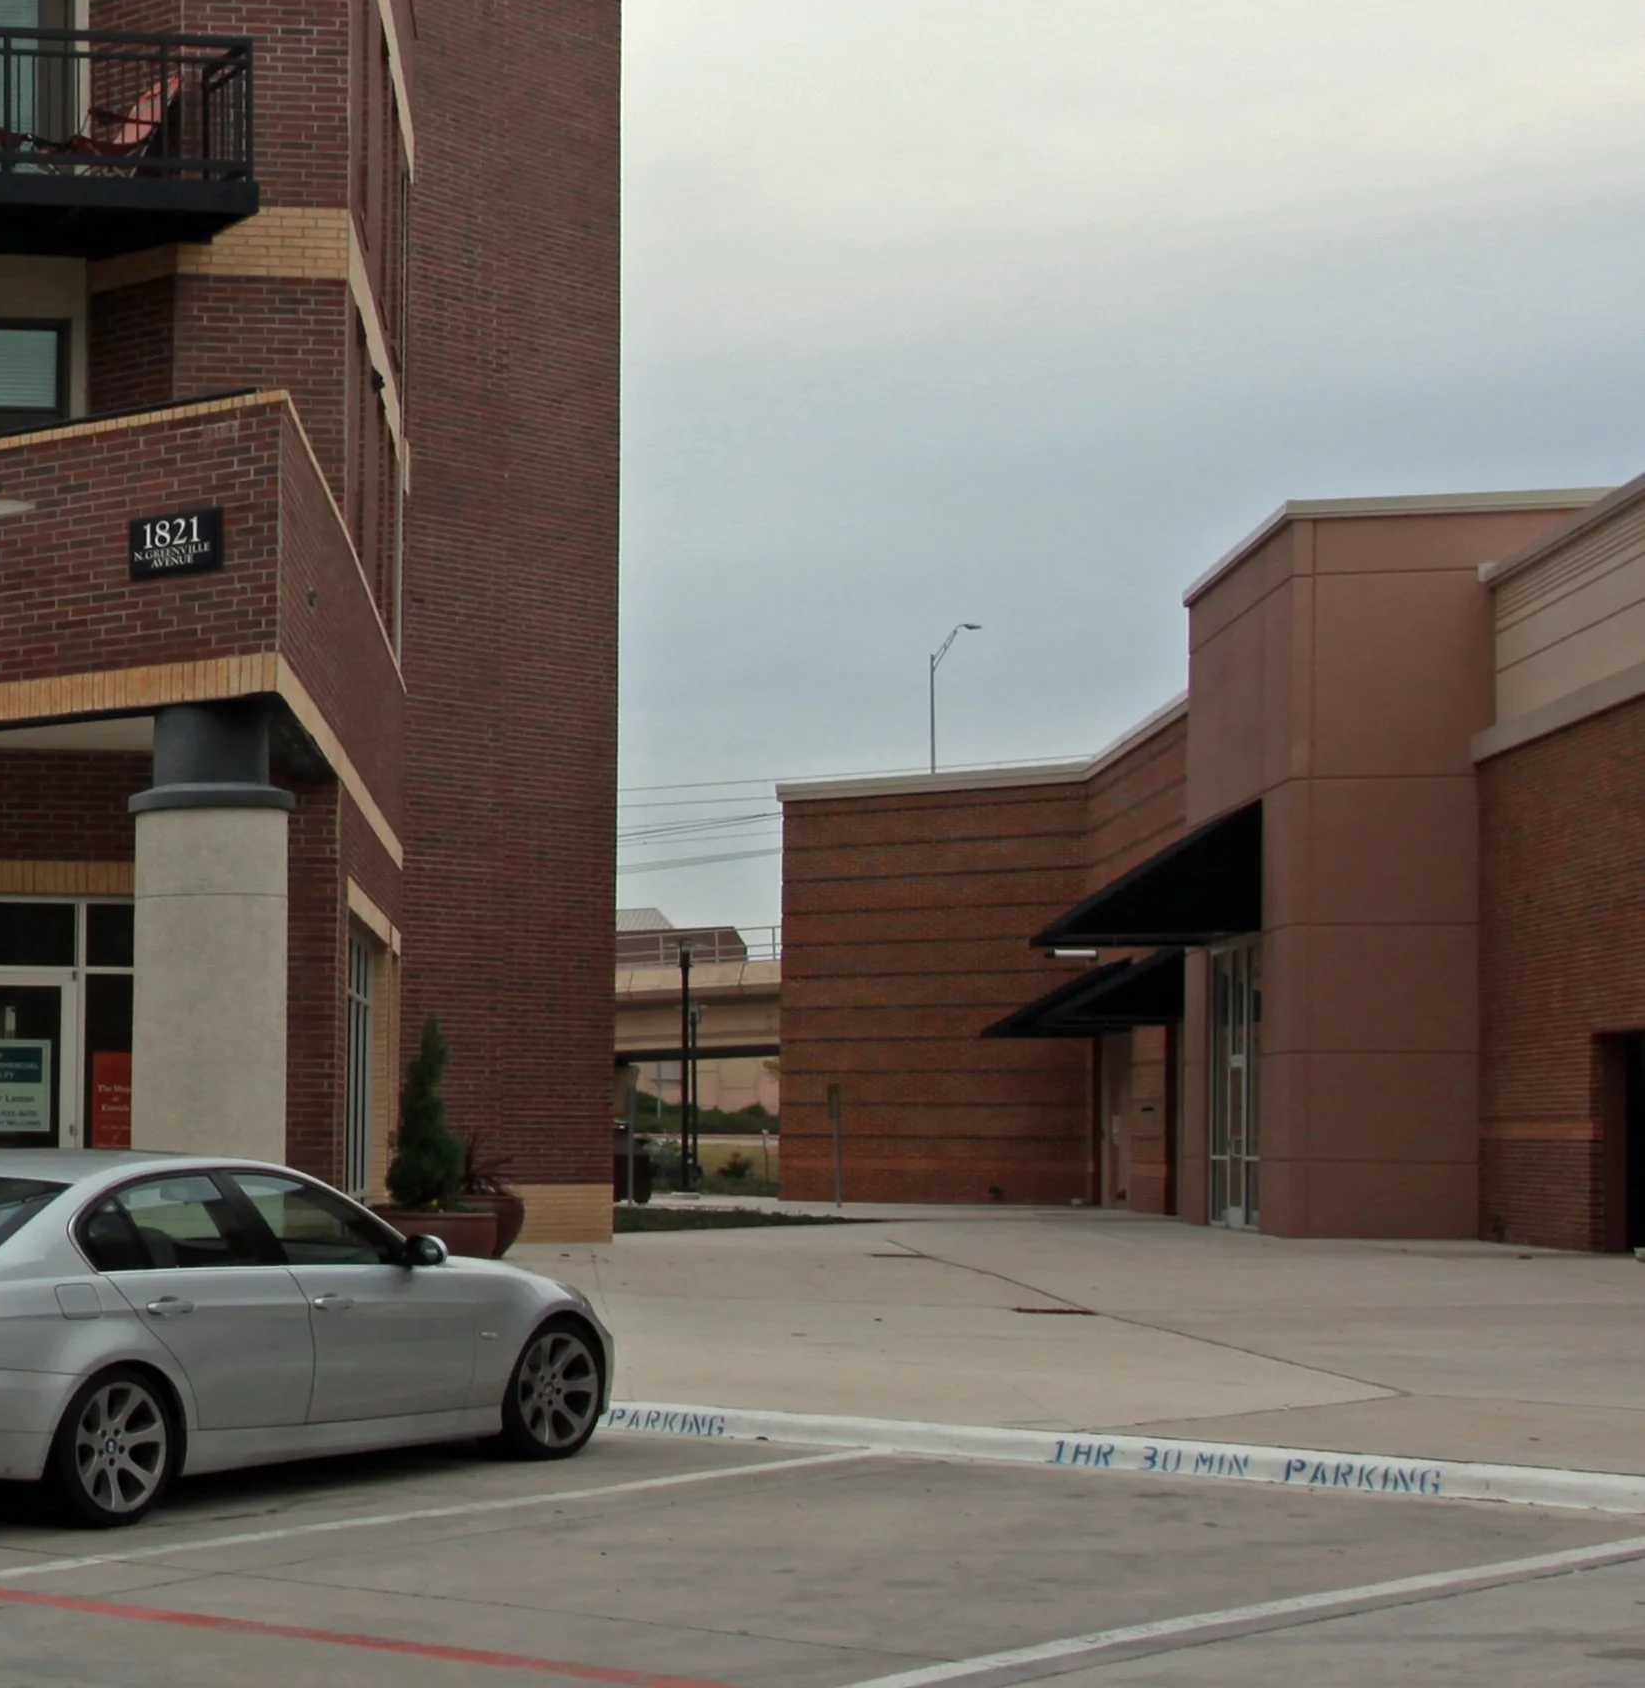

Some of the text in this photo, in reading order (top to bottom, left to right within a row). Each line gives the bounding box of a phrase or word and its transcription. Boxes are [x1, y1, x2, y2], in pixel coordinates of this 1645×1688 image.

[142, 515, 201, 550] 1821
[145, 541, 211, 560] GREENVILLE
[151, 554, 194, 569] AVENUE
[608, 1408, 726, 1437] PARKING
[1138, 1445, 1183, 1472] 30
[1193, 1451, 1251, 1478] MIN
[1284, 1458, 1442, 1496] PARKING
